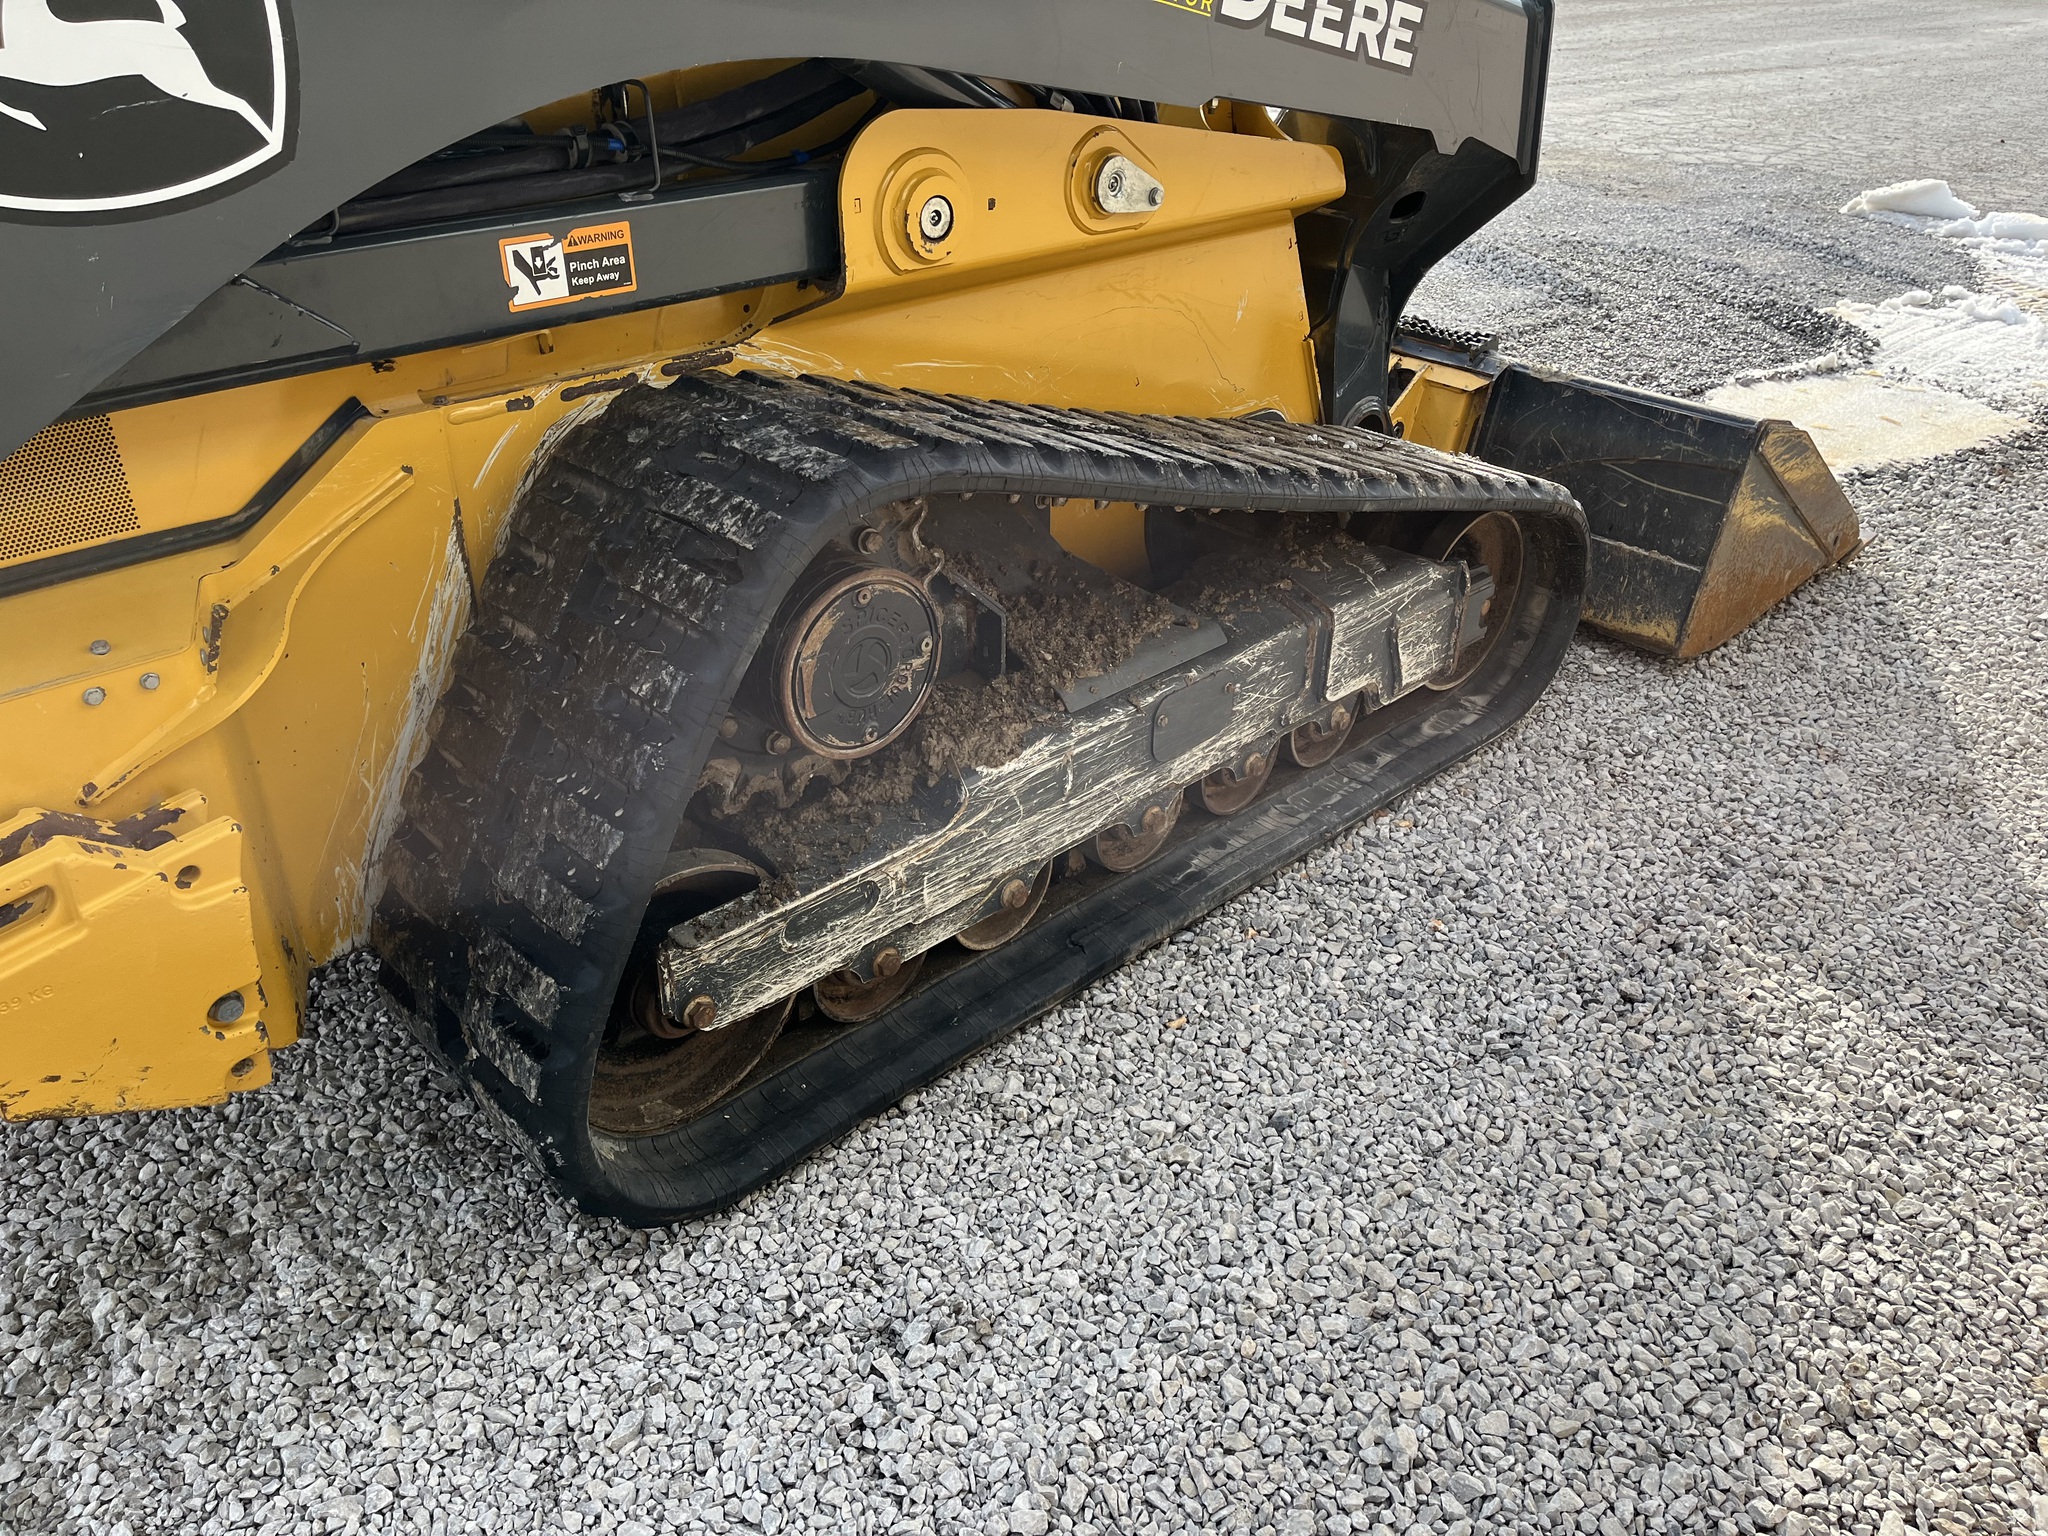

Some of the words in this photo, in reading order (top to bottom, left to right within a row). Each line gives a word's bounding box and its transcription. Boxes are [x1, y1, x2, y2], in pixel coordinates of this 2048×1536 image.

[577, 229, 625, 245] WARNING
[569, 258, 600, 273] Pinch
[601, 255, 626, 268] Area
[571, 276, 595, 287] Keep
[596, 271, 620, 282] Away
[28, 985, 54, 1003] KG
